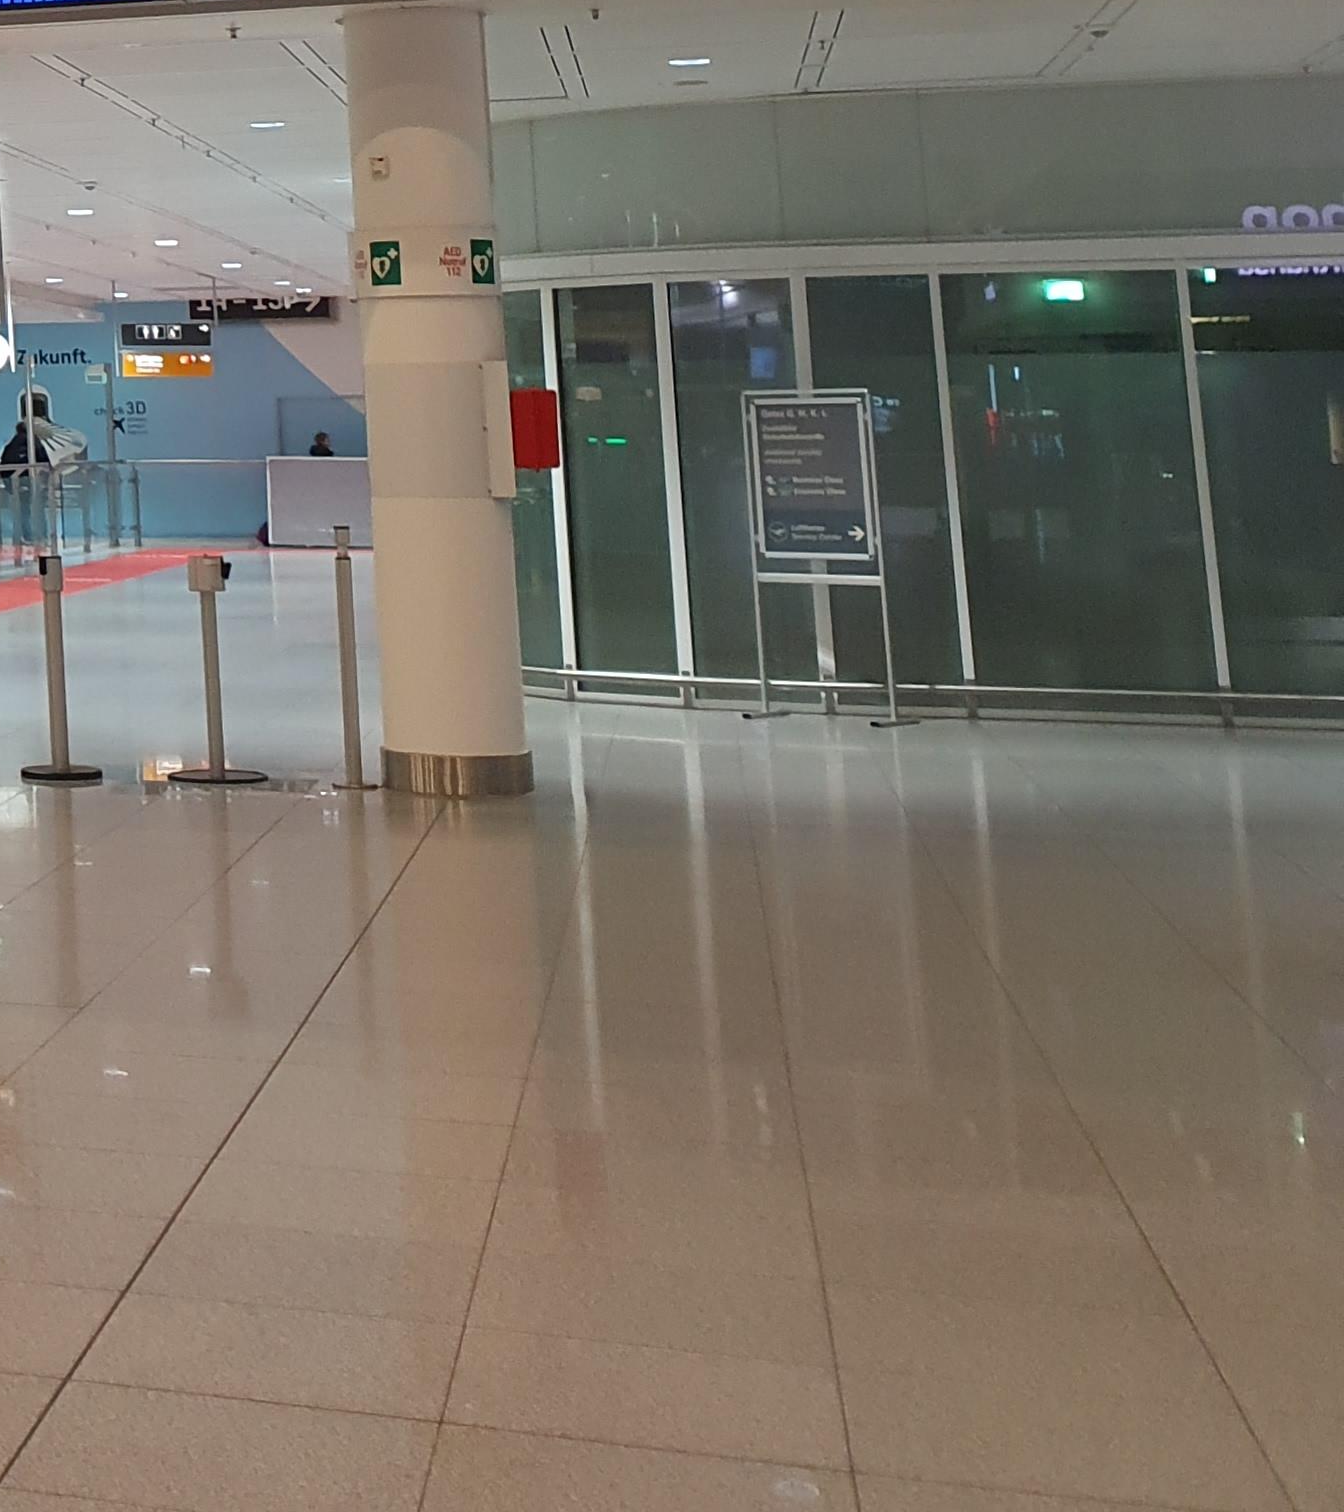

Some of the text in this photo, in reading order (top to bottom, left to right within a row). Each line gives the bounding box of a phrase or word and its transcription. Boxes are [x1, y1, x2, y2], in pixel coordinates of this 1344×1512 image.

[444, 247, 461, 256] AED
[447, 267, 460, 276] 112
[94, 401, 146, 415] chck 3D
